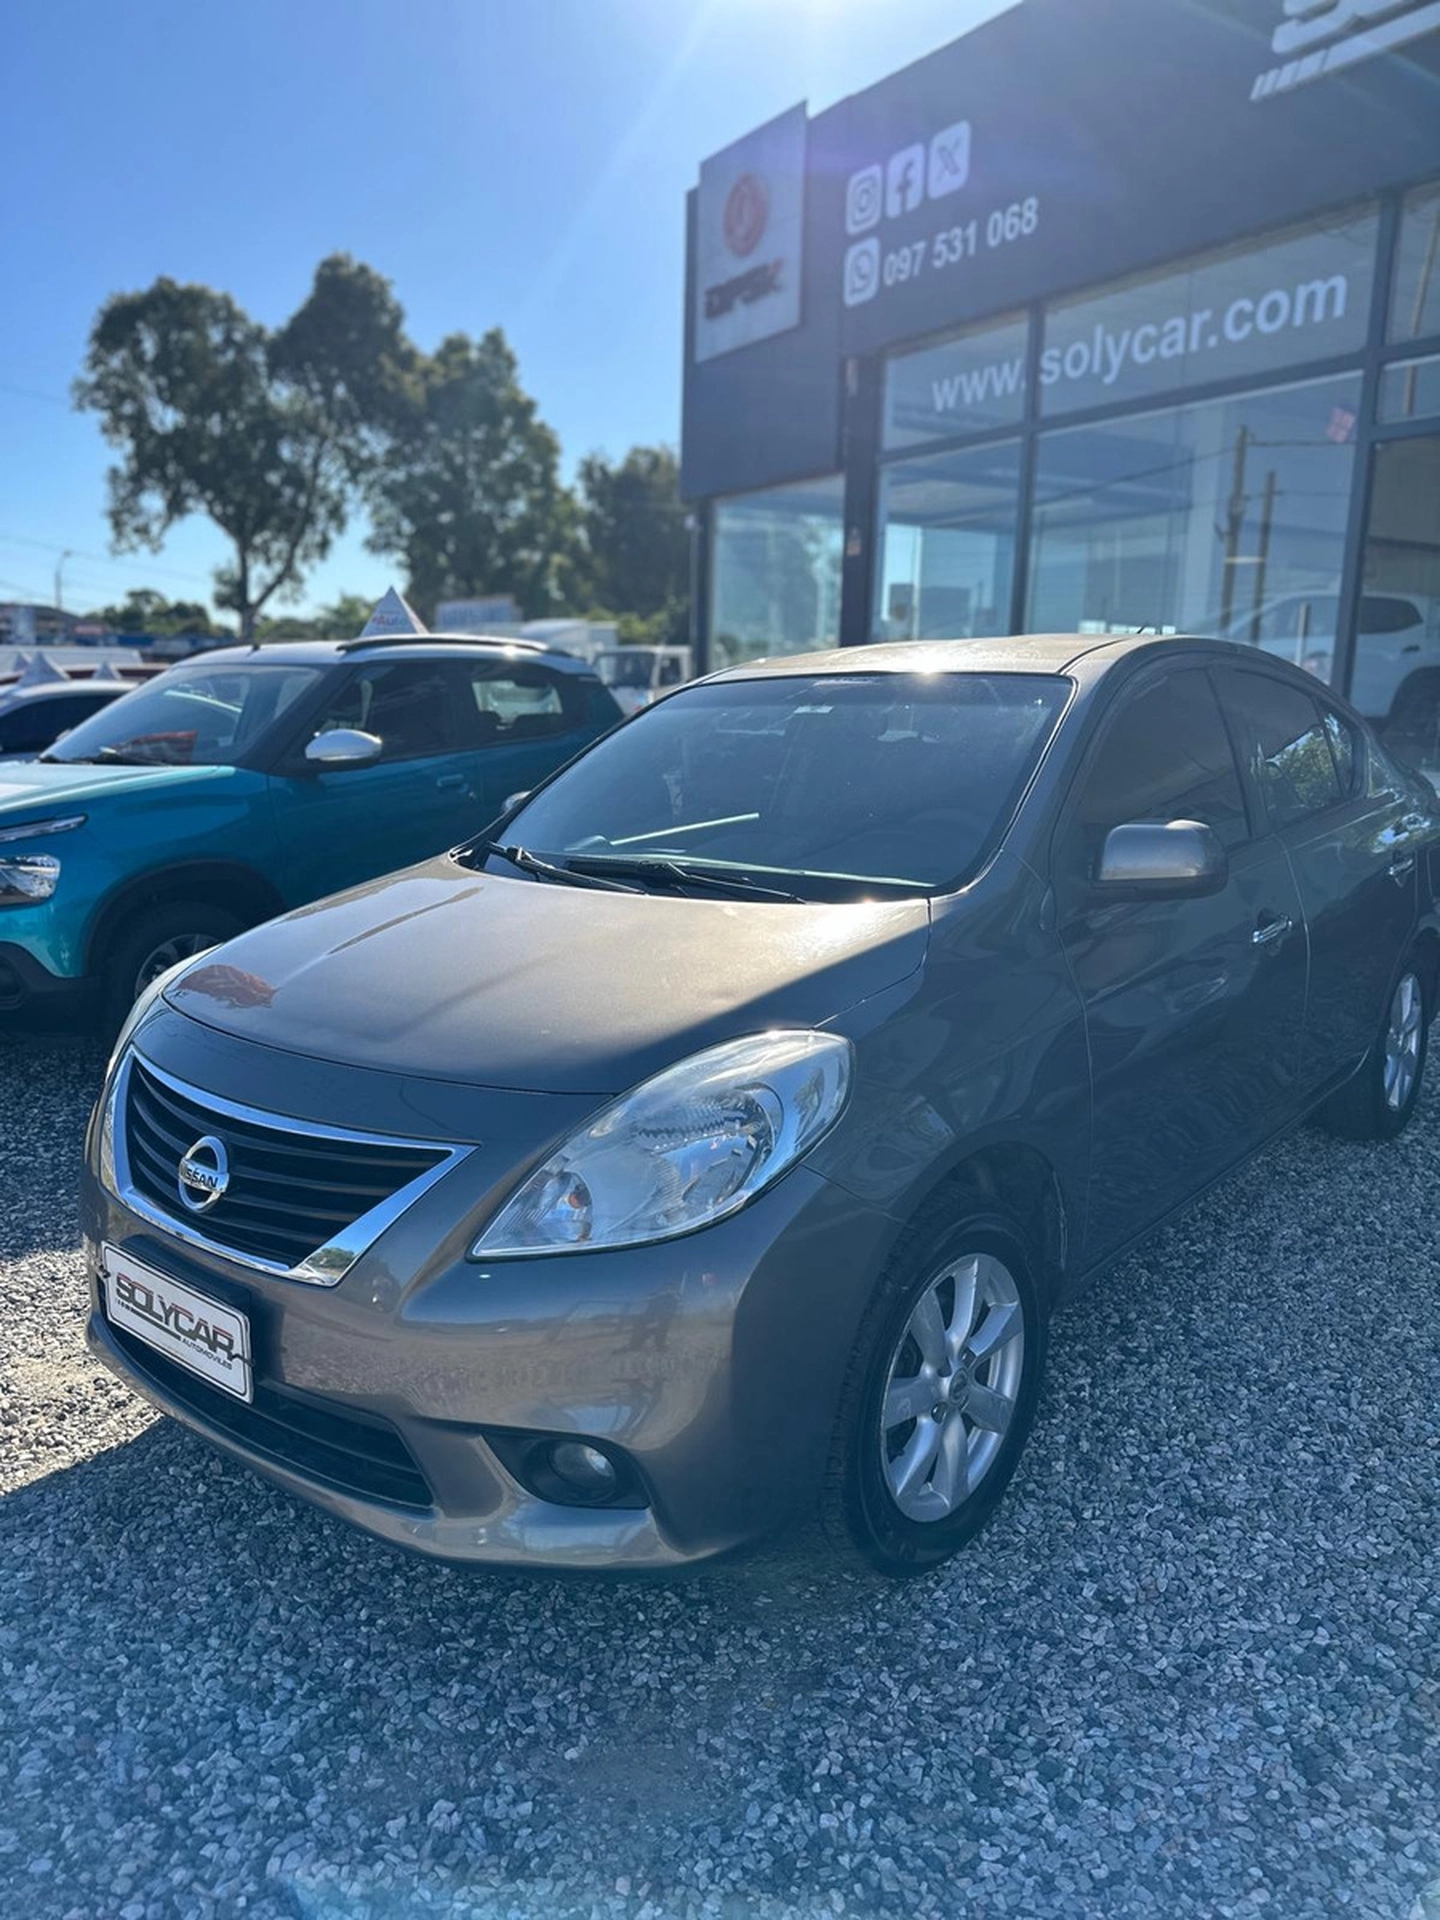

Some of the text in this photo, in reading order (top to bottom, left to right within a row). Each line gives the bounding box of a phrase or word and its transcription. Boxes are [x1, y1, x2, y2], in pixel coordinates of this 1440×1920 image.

[883, 196, 1039, 287] 097 531 068
[180, 1160, 219, 1188] SSAN
[116, 1271, 235, 1362] SOLYCAR
[182, 1337, 233, 1371] AUTOMOVILES
